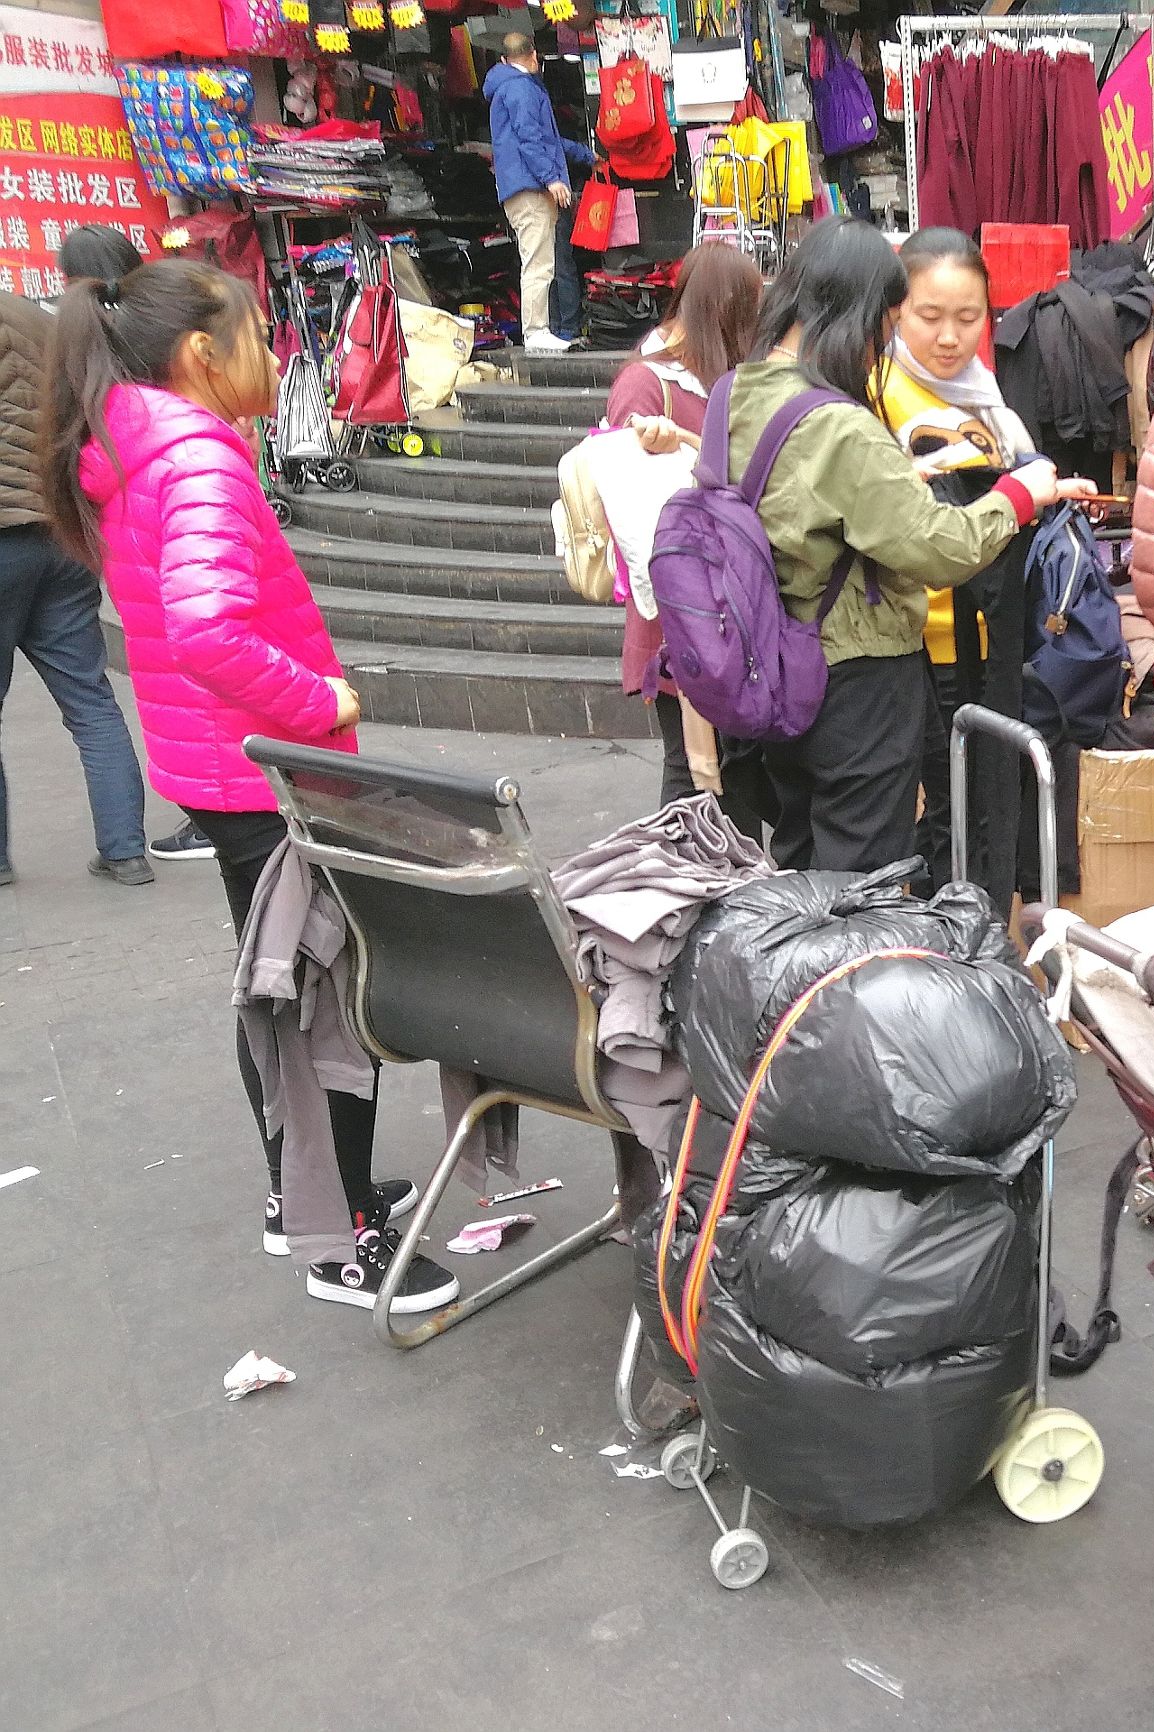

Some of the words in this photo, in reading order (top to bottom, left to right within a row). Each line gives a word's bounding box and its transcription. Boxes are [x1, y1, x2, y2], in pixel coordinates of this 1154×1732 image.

[0, 34, 115, 78] 服装批发城
[0, 165, 142, 209] 女装批发区
